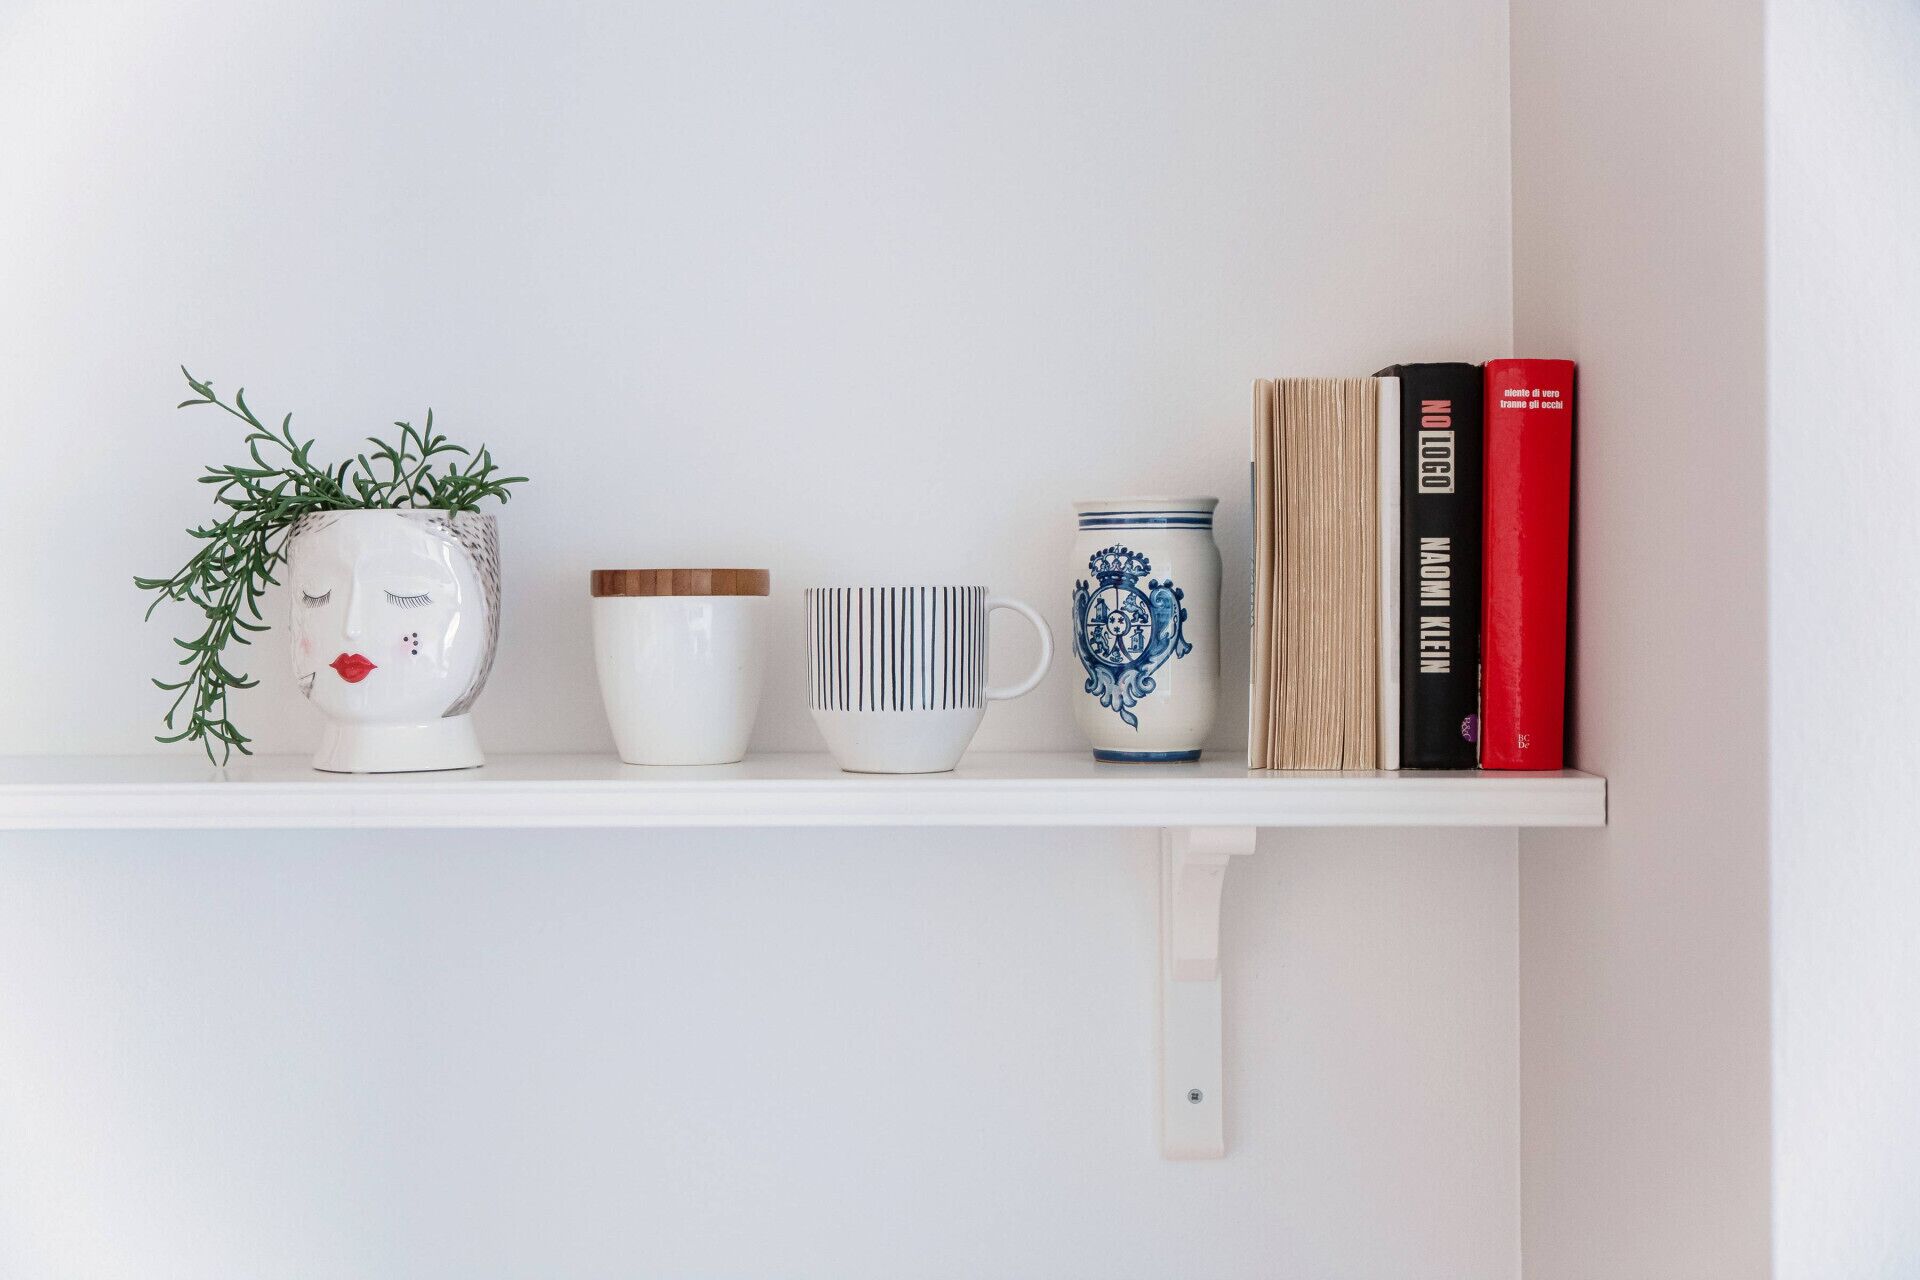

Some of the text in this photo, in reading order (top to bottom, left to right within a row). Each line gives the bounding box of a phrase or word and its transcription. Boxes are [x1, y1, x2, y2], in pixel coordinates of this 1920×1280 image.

[1500, 400, 1563, 410] tranne gli occhi
[1504, 388, 1560, 398] niente di vero
[1421, 400, 1452, 488] NO LOGO
[1420, 537, 1451, 673] NAOMI KLEIN
